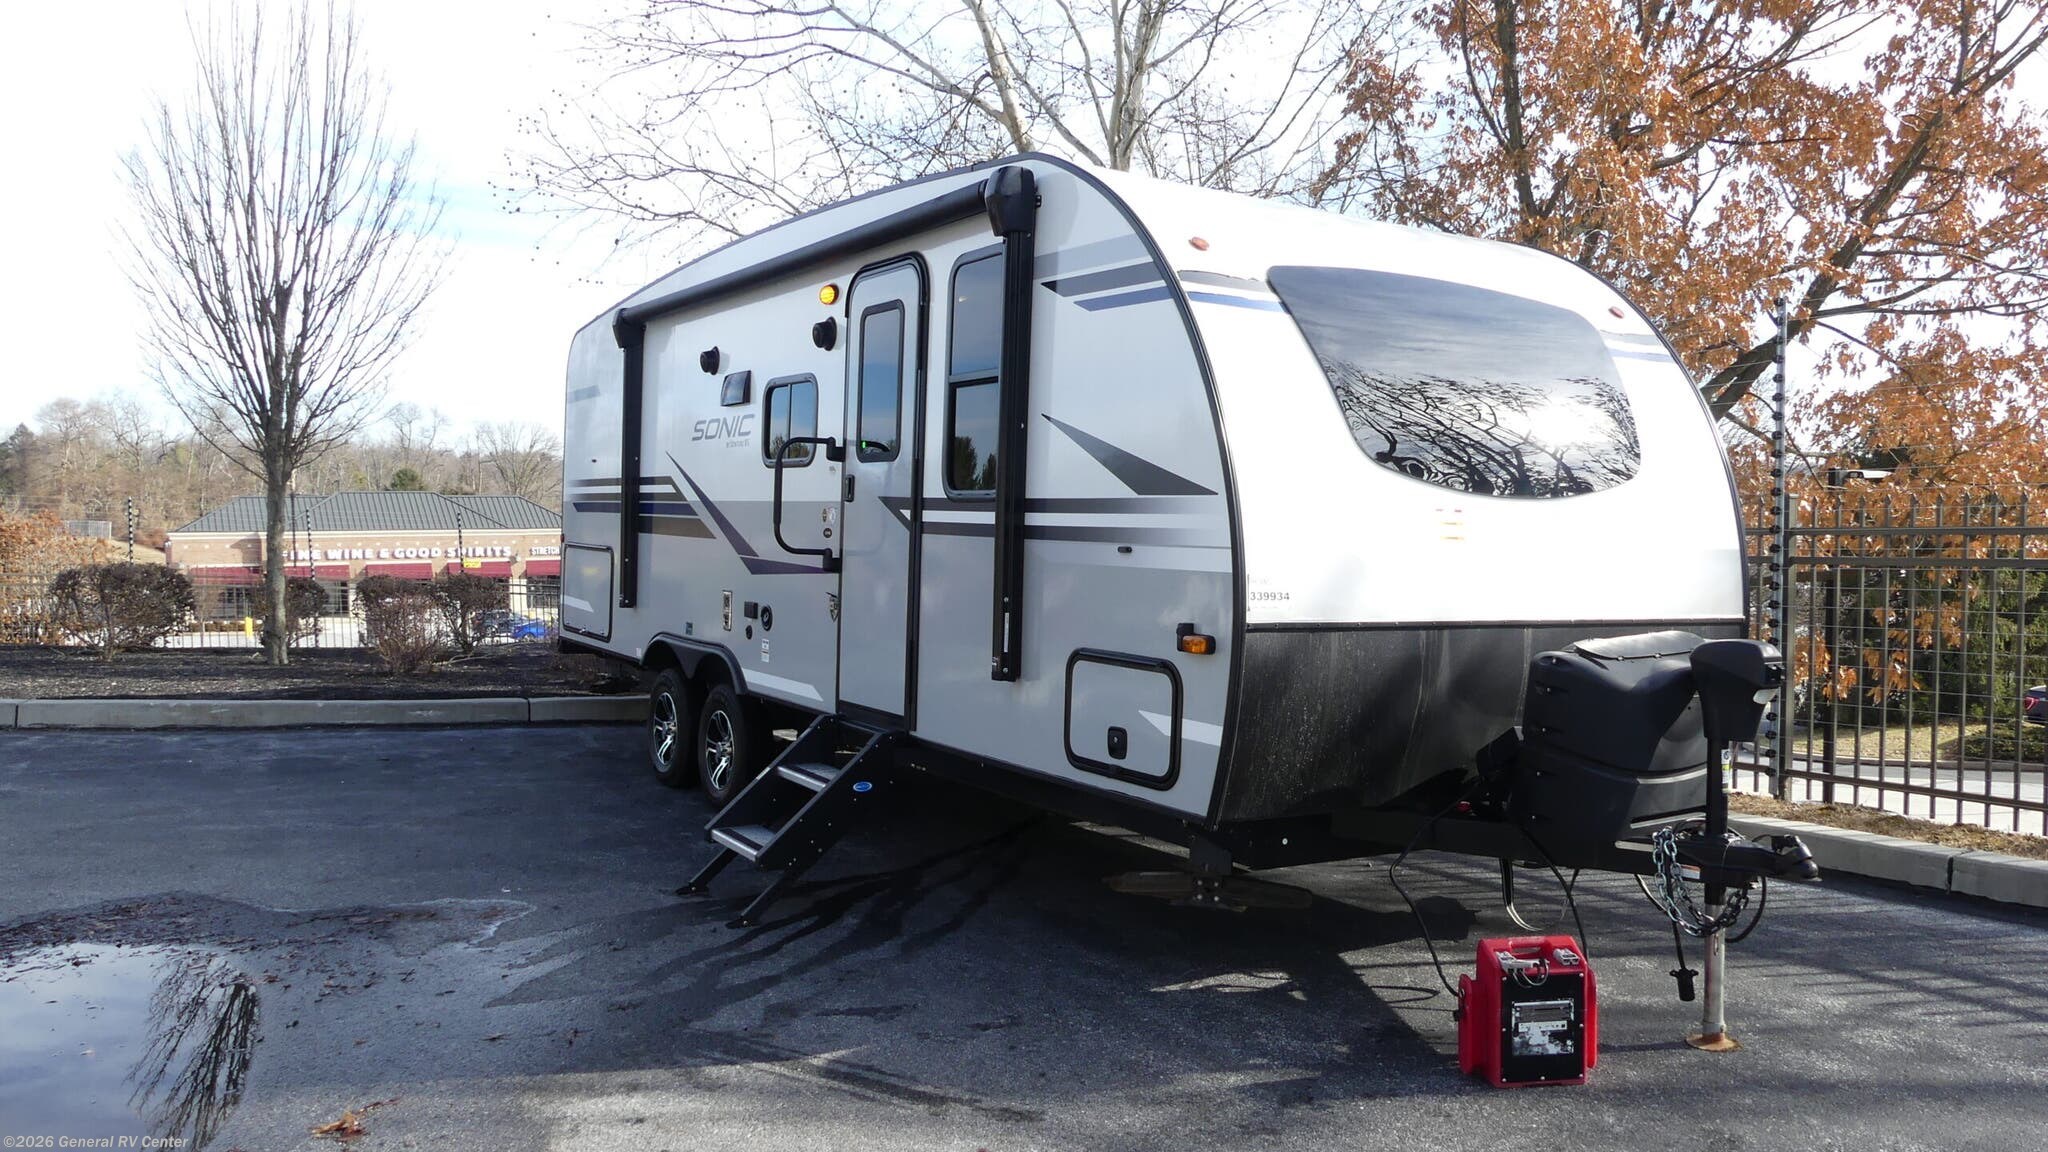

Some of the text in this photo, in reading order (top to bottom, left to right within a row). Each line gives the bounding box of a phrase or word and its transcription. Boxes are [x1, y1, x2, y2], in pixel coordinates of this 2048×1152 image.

[691, 413, 755, 441] SONIC
[327, 547, 374, 560] WINE
[379, 547, 389, 559] &
[394, 546, 442, 560] GOOD
[447, 545, 512, 558] SPIRITS
[1250, 592, 1290, 600] 339934
